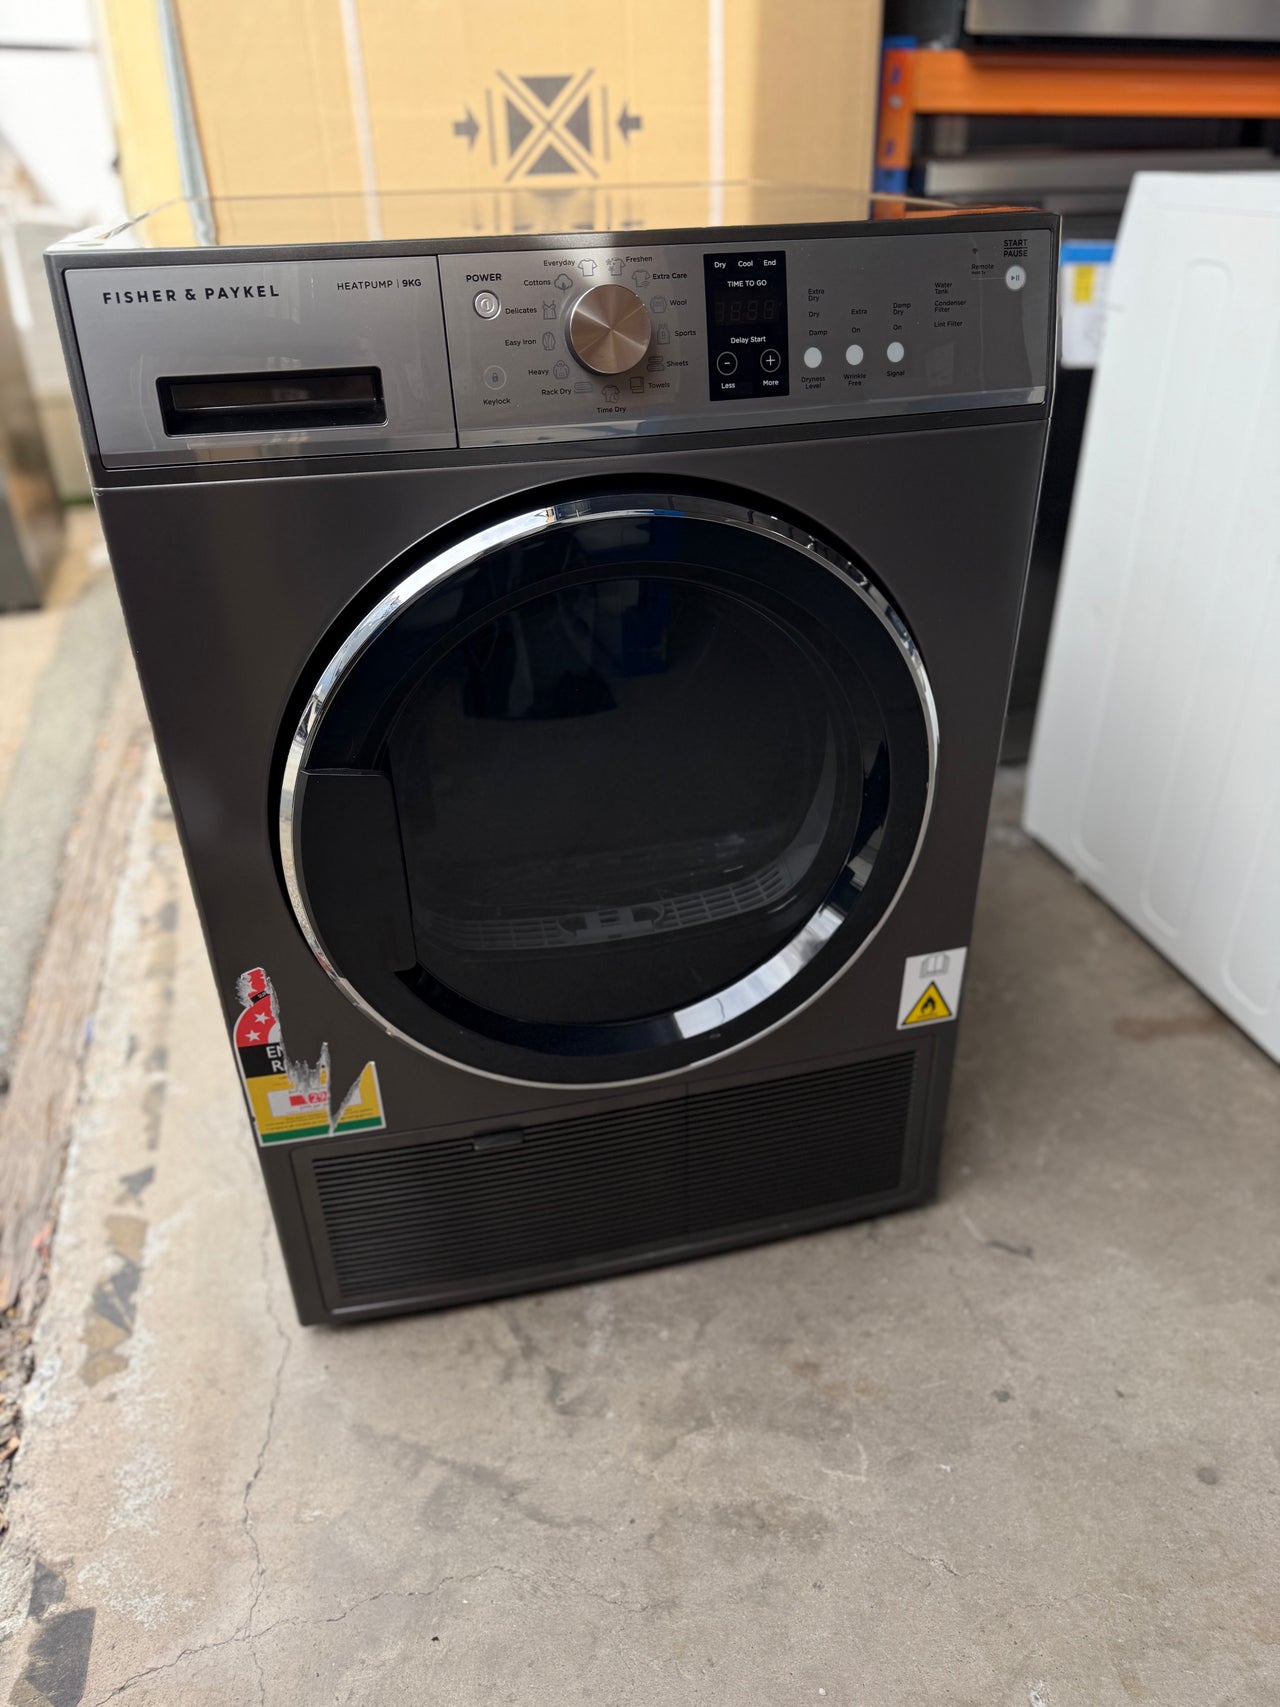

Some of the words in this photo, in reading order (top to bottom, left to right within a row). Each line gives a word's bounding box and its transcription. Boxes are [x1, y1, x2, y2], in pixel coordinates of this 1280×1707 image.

[1003, 239, 1028, 247] START
[1003, 249, 1028, 258] PAUSE
[543, 259, 575, 268] Everyday
[625, 255, 653, 263] Freshen
[714, 261, 727, 269] Dry
[466, 273, 502, 282] POWER
[652, 272, 671, 280] Extra
[337, 280, 393, 291] HEATPUMP
[402, 278, 422, 288] 9KG
[523, 279, 551, 287] Cottons
[103, 289, 177, 305] FISHER
[185, 288, 196, 301] &
[205, 285, 280, 300] PAYKEL
[505, 306, 537, 315] Delicates
[674, 329, 696, 338] Sports
[505, 339, 521, 348] Easy
[522, 338, 537, 346] Iron
[730, 337, 749, 345] Delay
[667, 360, 689, 368] Sheets
[528, 368, 549, 377] Heavy
[886, 370, 905, 378] Signal
[648, 381, 670, 389] Towels
[557, 388, 572, 396] Dry
[483, 397, 511, 407] Keylock
[612, 406, 627, 415] Dry
